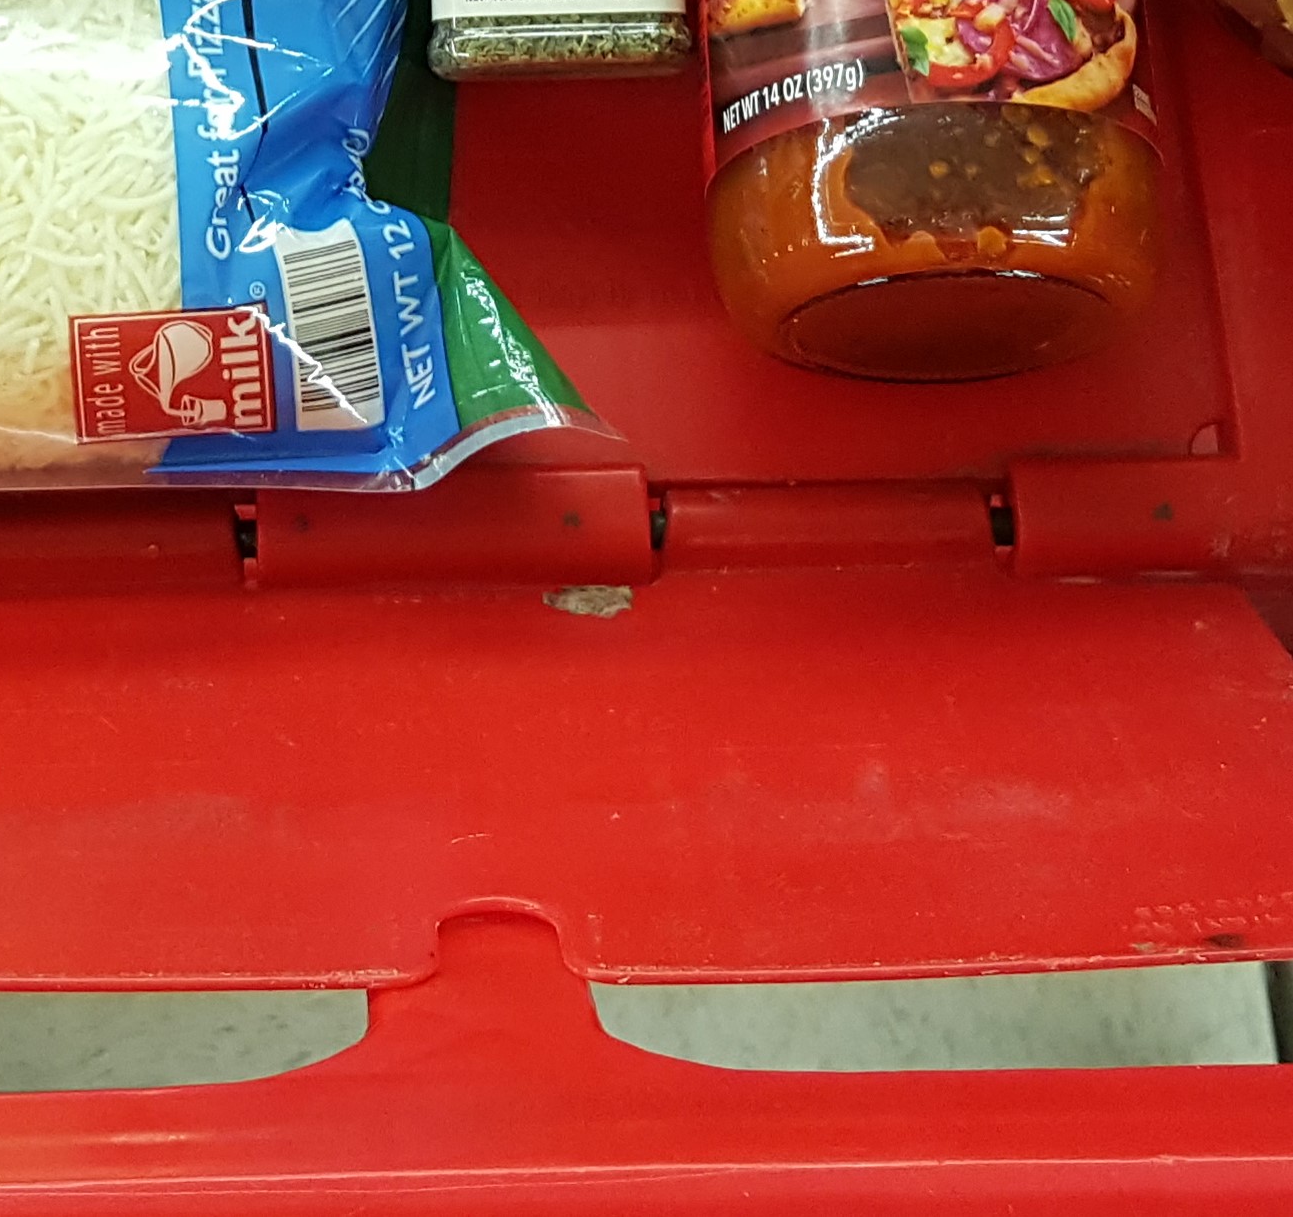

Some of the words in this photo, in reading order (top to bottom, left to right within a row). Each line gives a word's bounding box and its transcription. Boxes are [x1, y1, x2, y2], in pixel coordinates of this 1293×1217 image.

[722, 100, 742, 134] NET
[740, 89, 760, 122] WT
[762, 81, 781, 111] 14
[782, 73, 804, 103] OZ
[806, 57, 865, 100] (397g)
[205, 148, 240, 261] Great
[382, 219, 412, 261] 12
[393, 271, 424, 338] WT
[80, 325, 122, 375] with
[219, 315, 264, 427] milk
[401, 343, 437, 411] NET
[97, 381, 126, 434] made
